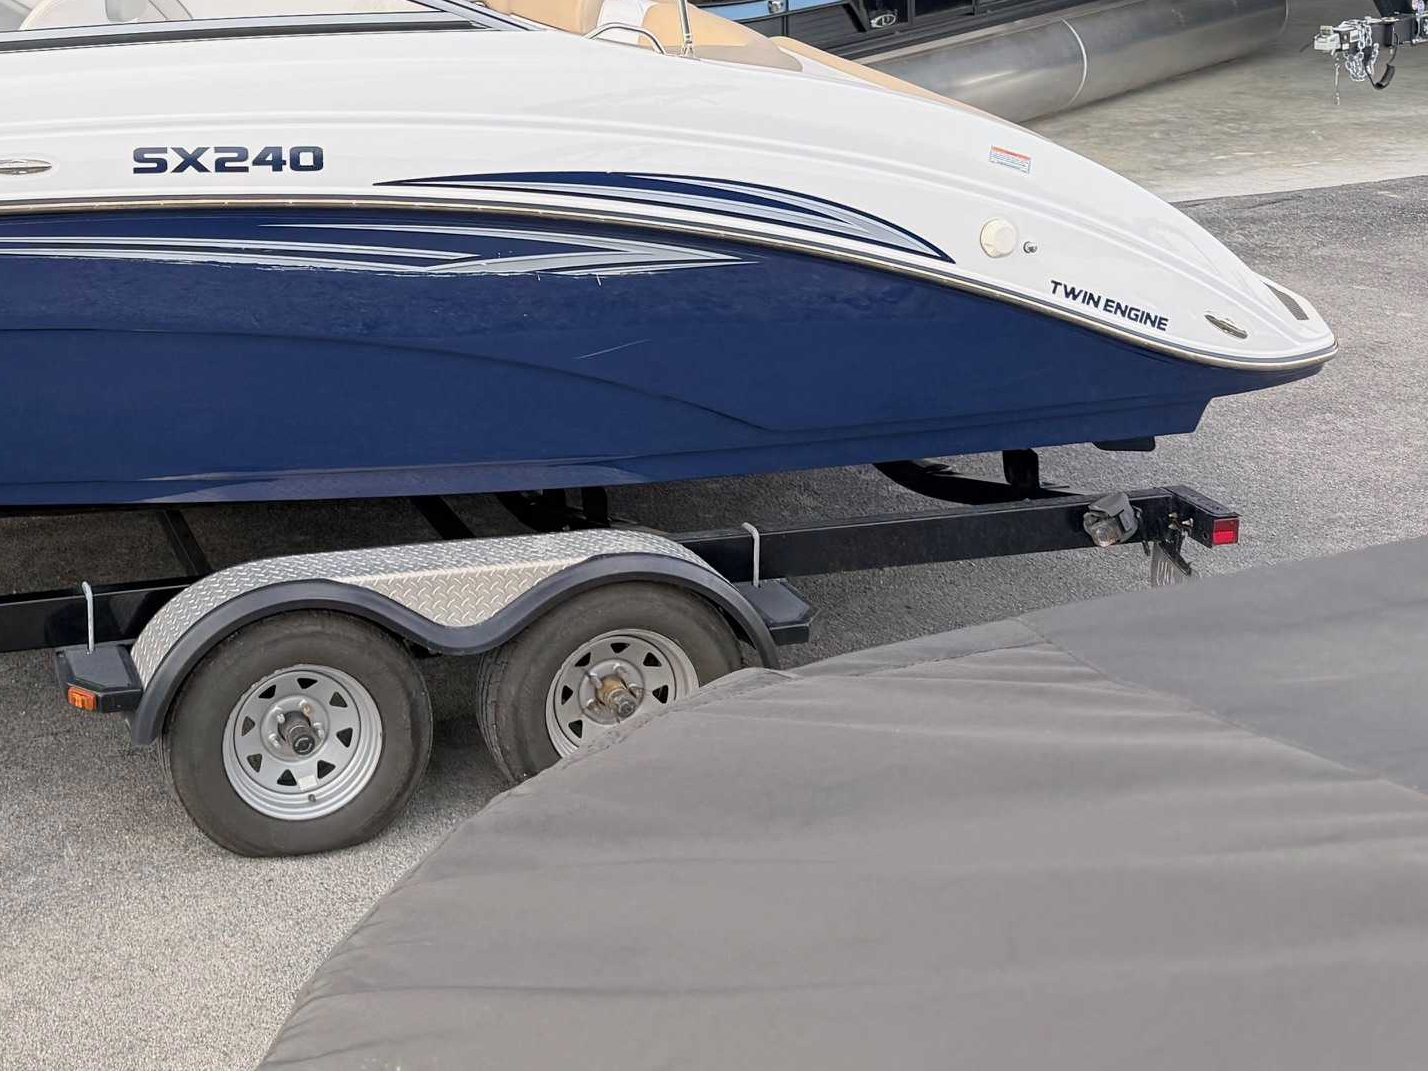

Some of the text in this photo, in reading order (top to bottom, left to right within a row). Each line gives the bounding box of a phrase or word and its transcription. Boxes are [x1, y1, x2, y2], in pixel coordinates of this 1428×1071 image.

[133, 145, 324, 174] SX240
[1051, 280, 1169, 331] TWIN ENGINE
